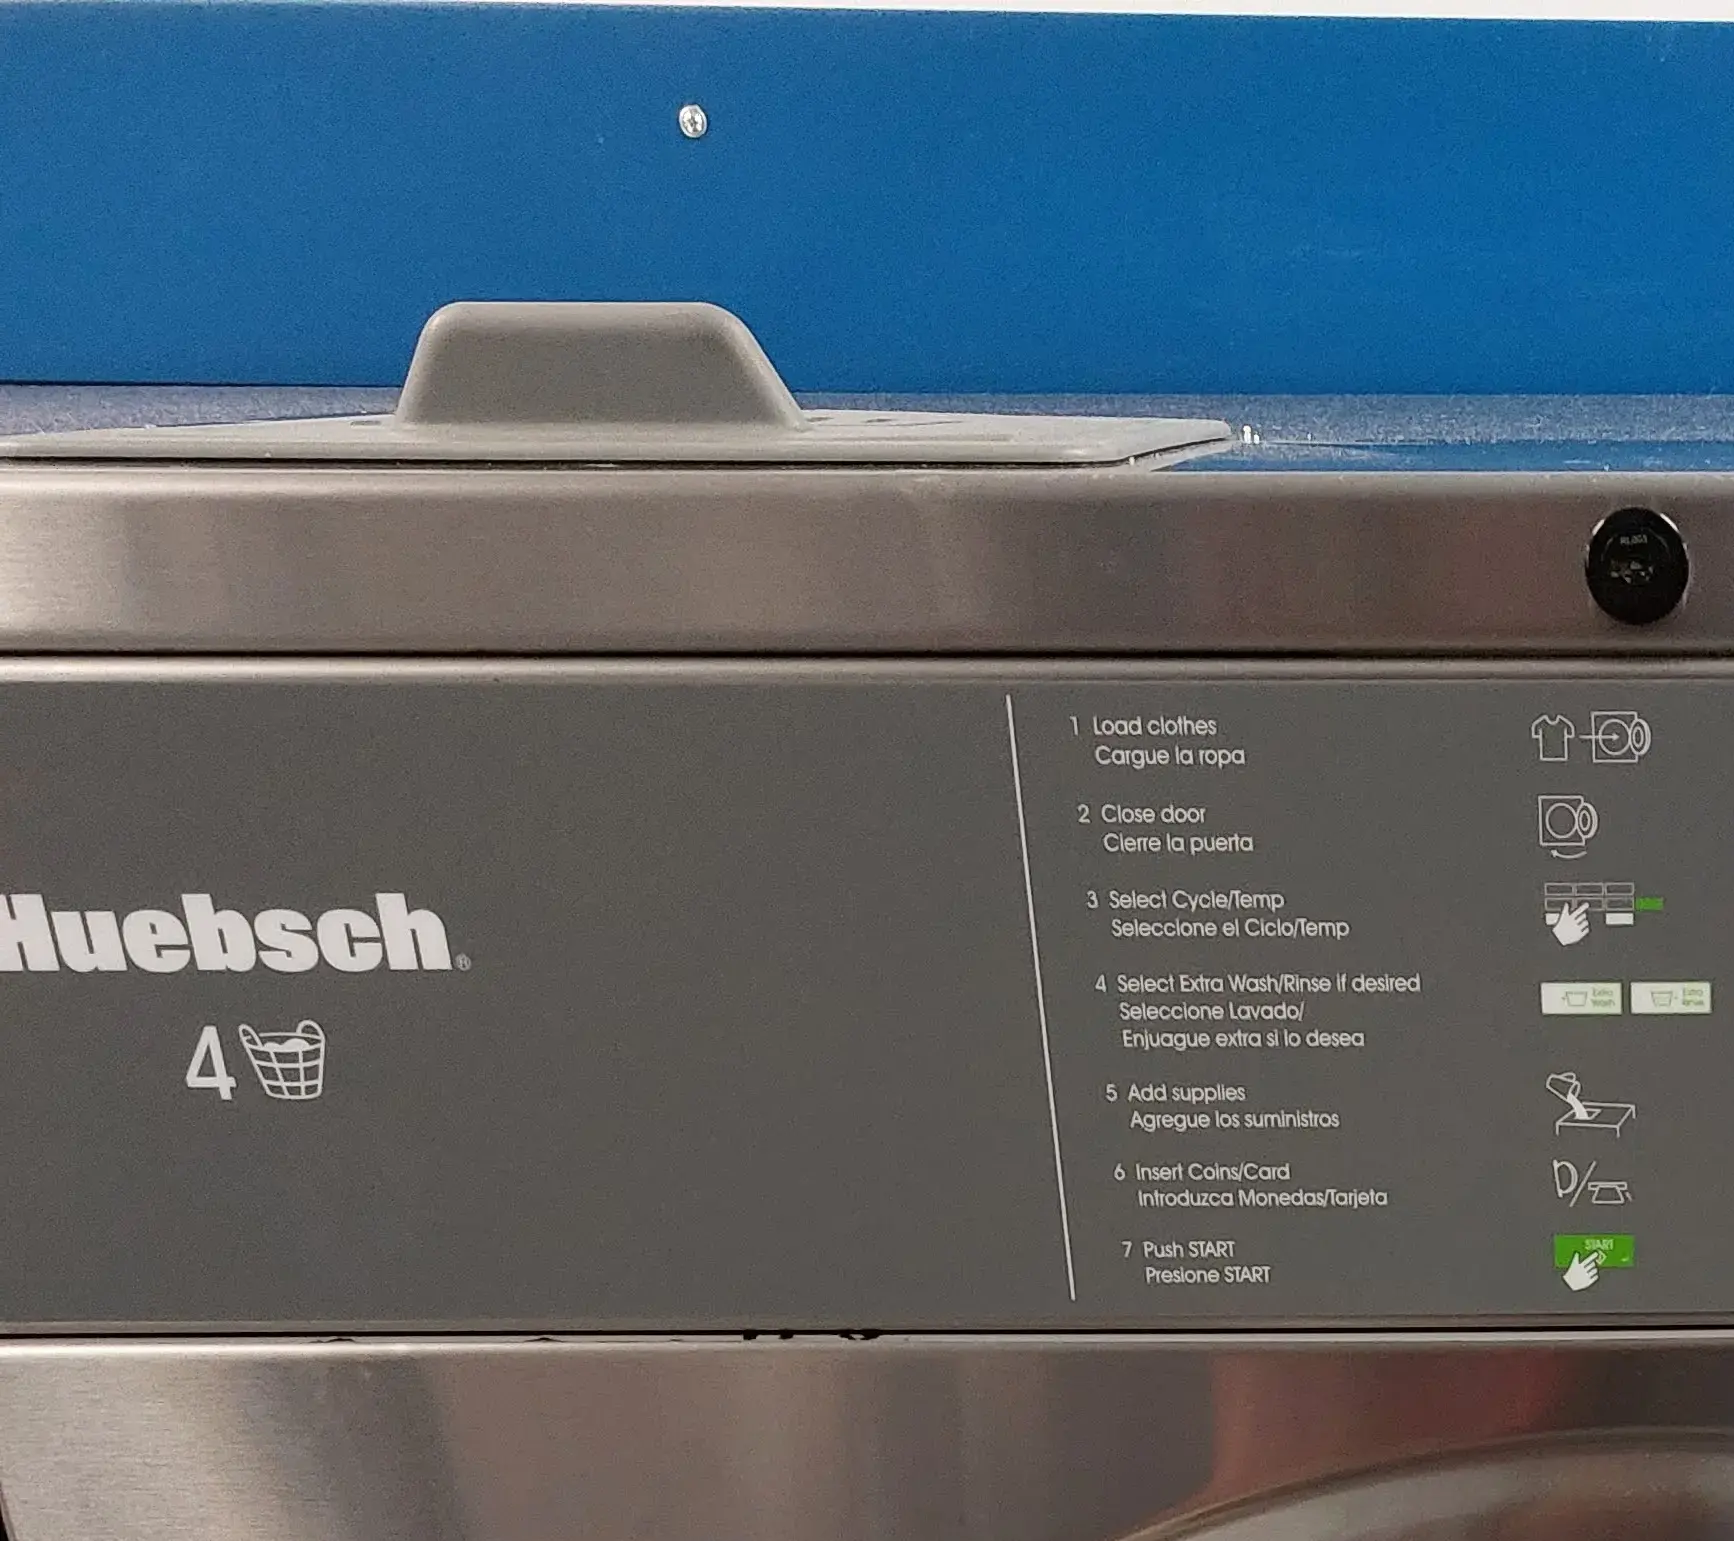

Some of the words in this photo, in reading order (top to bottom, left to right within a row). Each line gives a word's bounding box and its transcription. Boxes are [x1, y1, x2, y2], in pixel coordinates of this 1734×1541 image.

[1070, 717, 1078, 735] 1
[1093, 716, 1142, 735] Load
[1147, 716, 1216, 735] clothes
[1095, 746, 1169, 769] Cargue
[1175, 746, 1193, 764] la
[1199, 750, 1245, 768] ropa
[1078, 804, 1090, 823] 2
[1102, 804, 1155, 823] Close
[1161, 805, 1205, 823] door
[1104, 833, 1161, 851] Cierre
[1167, 833, 1184, 851] la
[1190, 834, 1253, 855] puerta
[1087, 891, 1098, 908] 3
[1110, 890, 1166, 908] Select
[1172, 890, 1284, 912] Cycle/Temp
[0, 893, 452, 973] Huebsch
[1112, 919, 1217, 936] Seleccione
[1222, 919, 1239, 936] el
[1245, 918, 1349, 940] Ciclo/Temp
[1095, 975, 1106, 991] 4
[1118, 975, 1174, 992] Select
[1179, 975, 1223, 992] Extra
[1228, 974, 1331, 993] Wash/Rinse
[1337, 974, 1346, 991] if
[1352, 974, 1420, 992] desired
[1120, 1002, 1224, 1020] Seleccione
[1229, 1002, 1304, 1021] Lavado/
[1123, 1030, 1210, 1051] Enjuague
[1216, 1030, 1261, 1047] extra
[1267, 1029, 1279, 1046] si
[1284, 1029, 1301, 1047] lo
[1306, 1030, 1364, 1046] desea
[185, 1026, 237, 1100] 4
[1106, 1084, 1117, 1101] 5
[1128, 1084, 1167, 1101] Add
[1172, 1084, 1245, 1104] supplies
[1131, 1111, 1210, 1132] Agregue
[1215, 1110, 1240, 1127] los
[1245, 1110, 1339, 1127] suministros
[1115, 1164, 1125, 1180] 6
[1136, 1164, 1183, 1180] Insert
[1188, 1163, 1290, 1181] Coins/Card
[1139, 1190, 1234, 1206] Introduzca
[1239, 1189, 1387, 1208] Monedas/Tarjeta
[1122, 1241, 1132, 1257] 7
[1143, 1241, 1184, 1257] Push
[1189, 1241, 1235, 1257] START
[1585, 1239, 1613, 1250] START
[1146, 1267, 1219, 1283] Presione
[1225, 1266, 1270, 1282] START
